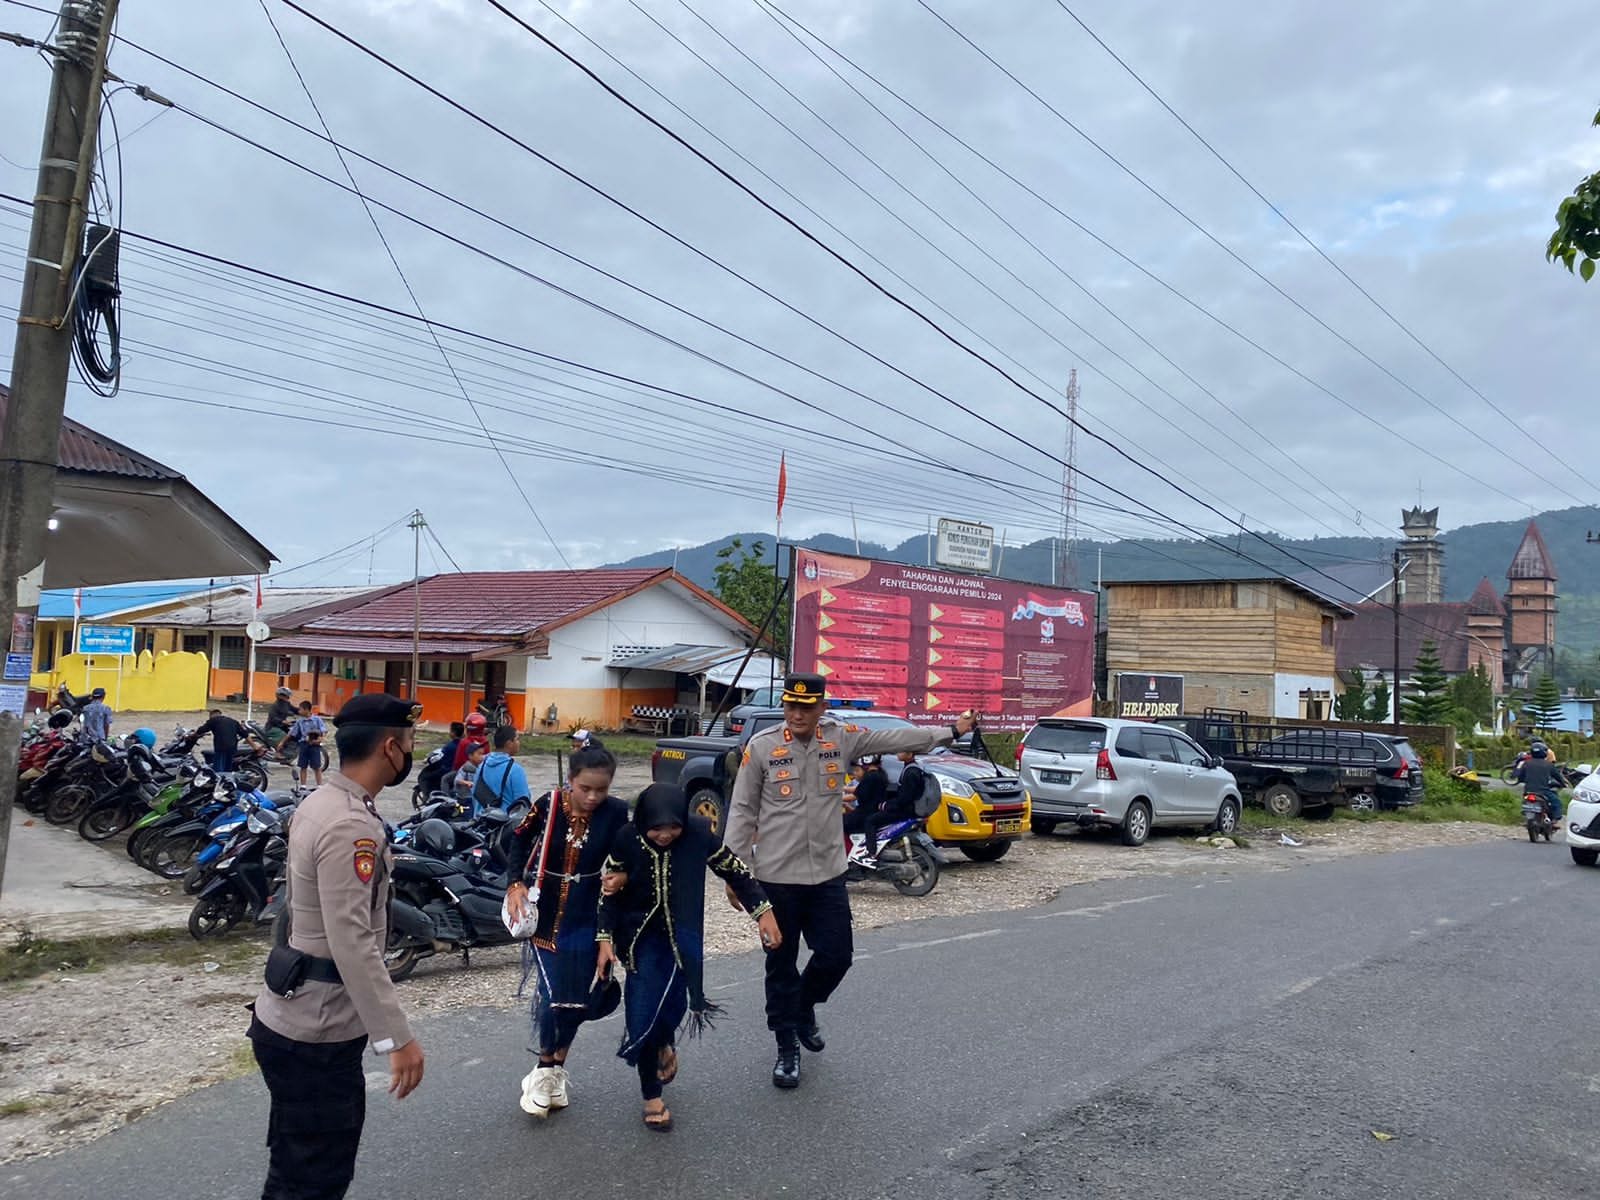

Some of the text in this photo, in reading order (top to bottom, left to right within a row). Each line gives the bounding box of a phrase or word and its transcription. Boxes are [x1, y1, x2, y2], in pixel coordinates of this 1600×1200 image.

[902, 570, 985, 589] TAHAPAN DAN JADWAL
[880, 578, 1002, 601] PENYELENGGARAAN PEMILU 2024
[1121, 702, 1179, 717] HELPDESK
[662, 750, 686, 759] PATROLI
[819, 751, 841, 759] POLRI
[769, 758, 793, 767] ROCKY
